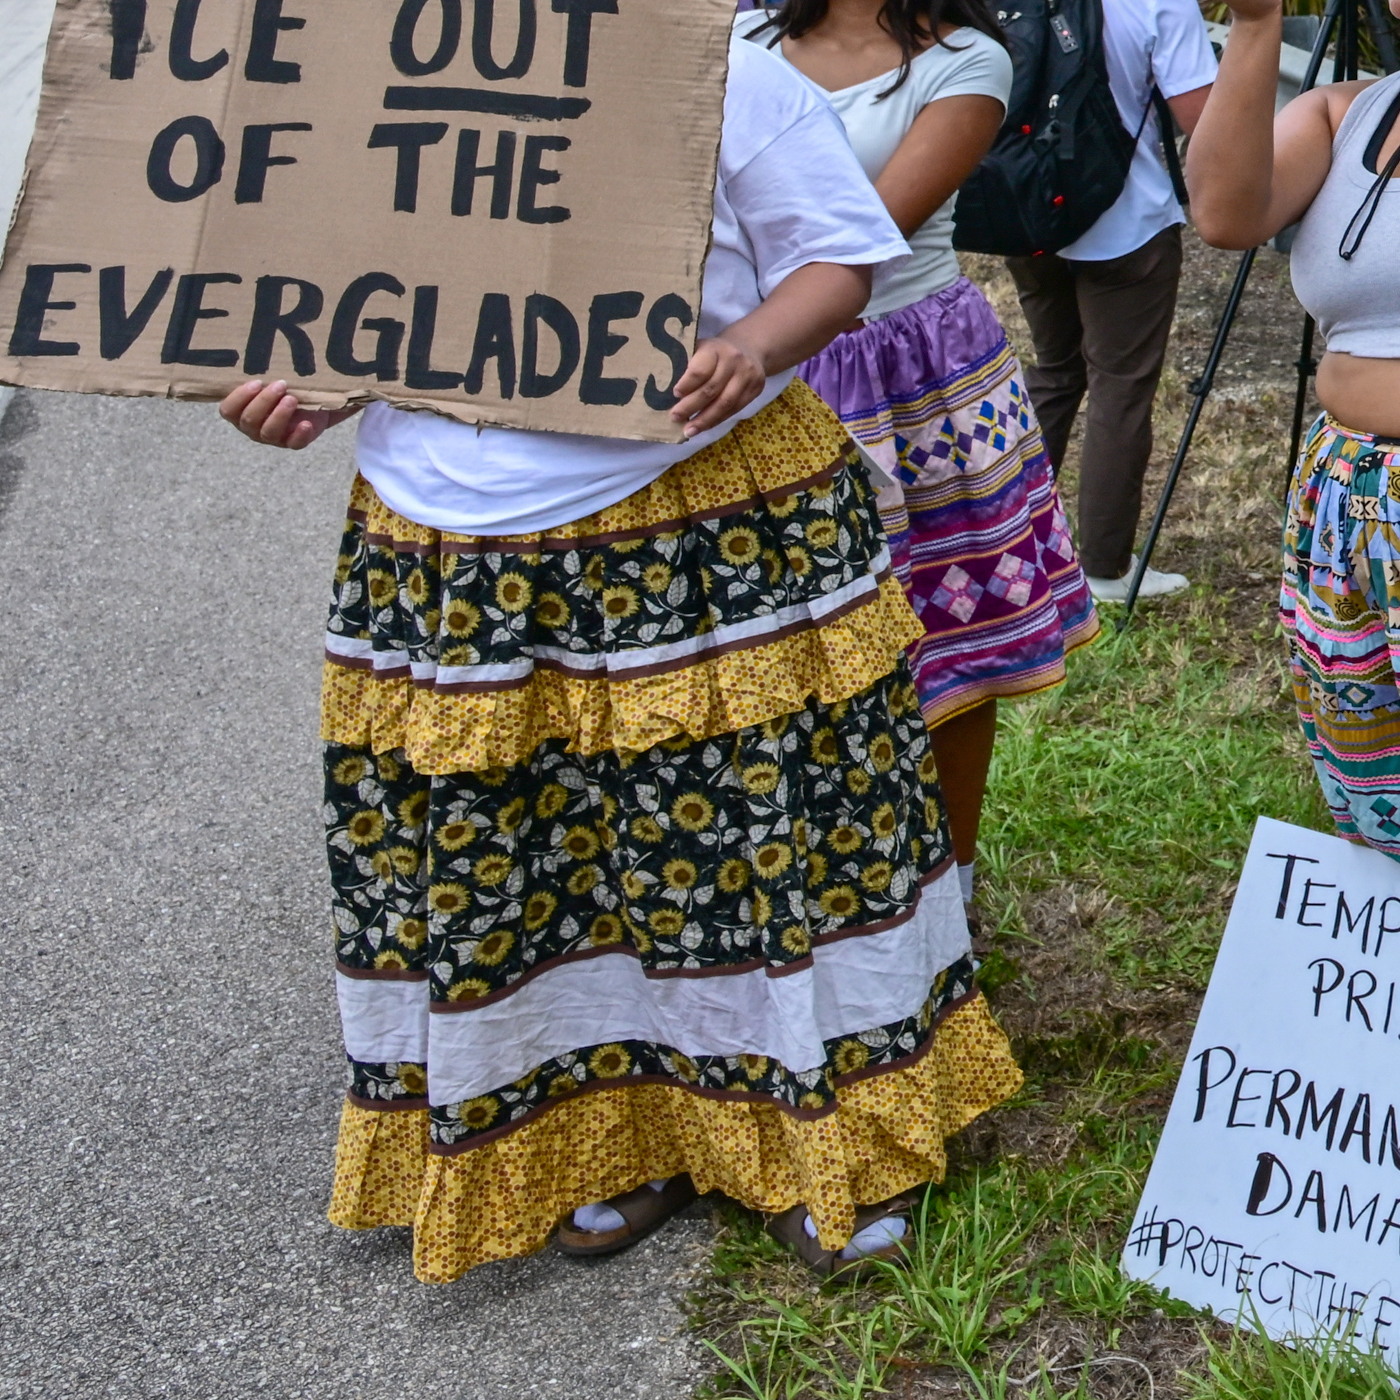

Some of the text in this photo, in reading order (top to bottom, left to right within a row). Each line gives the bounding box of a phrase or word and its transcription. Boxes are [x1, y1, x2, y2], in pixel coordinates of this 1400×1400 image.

[146, 115, 572, 224] OF THE
[8, 263, 694, 411] EVERGLADES
